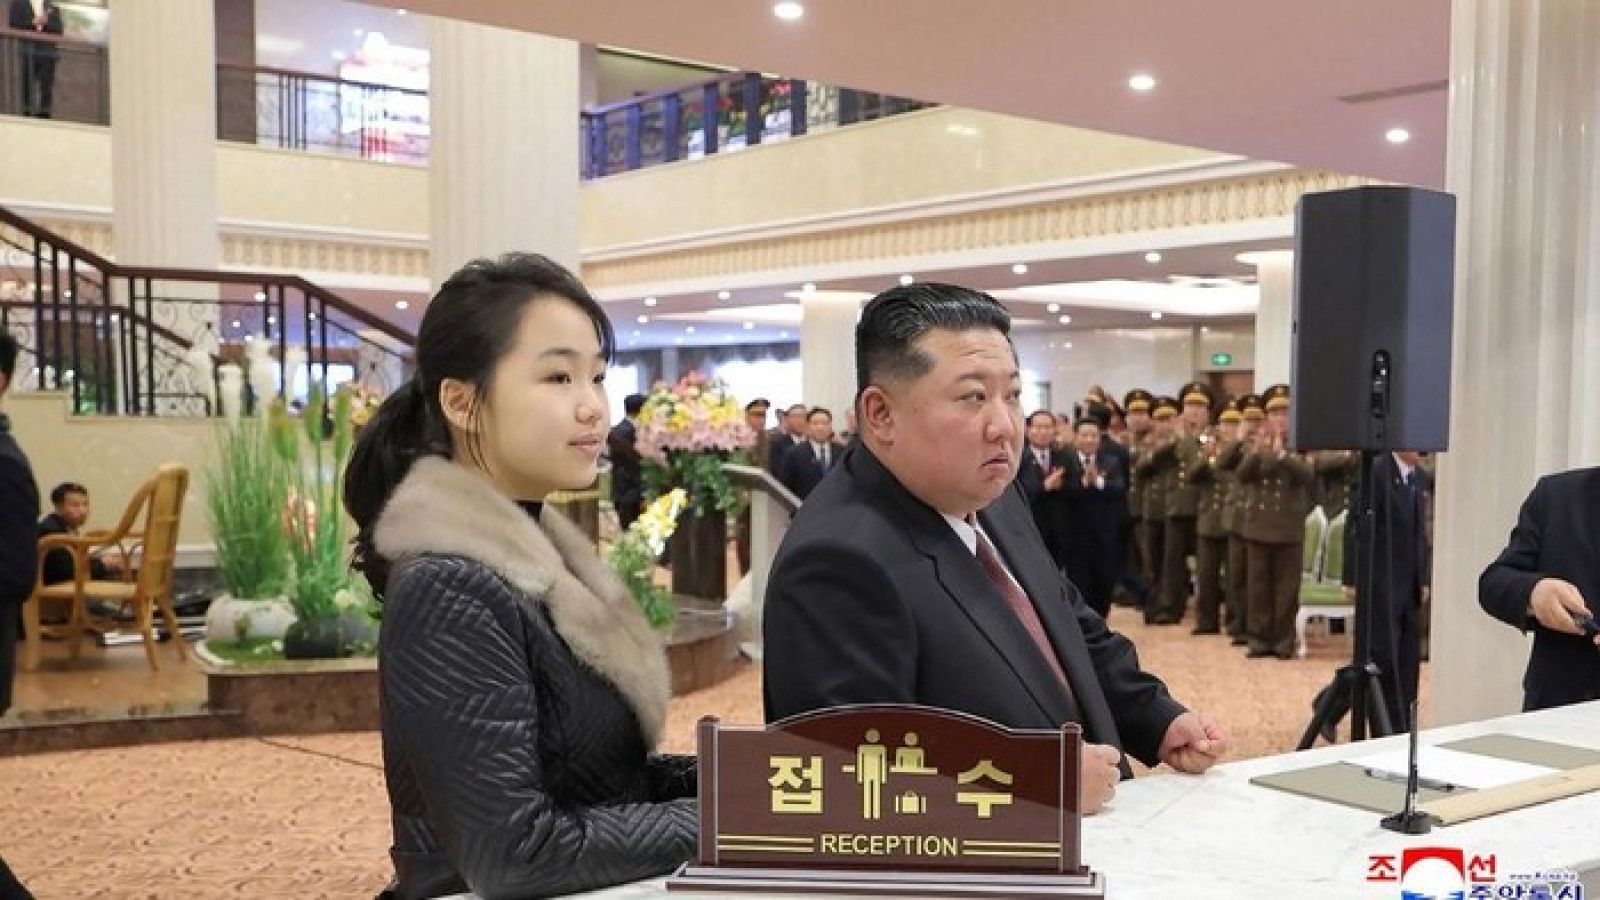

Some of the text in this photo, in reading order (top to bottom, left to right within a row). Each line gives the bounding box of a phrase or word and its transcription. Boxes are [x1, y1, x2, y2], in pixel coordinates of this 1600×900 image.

[768, 756, 1013, 819] 접 수
[820, 834, 958, 856] RECEPTION
